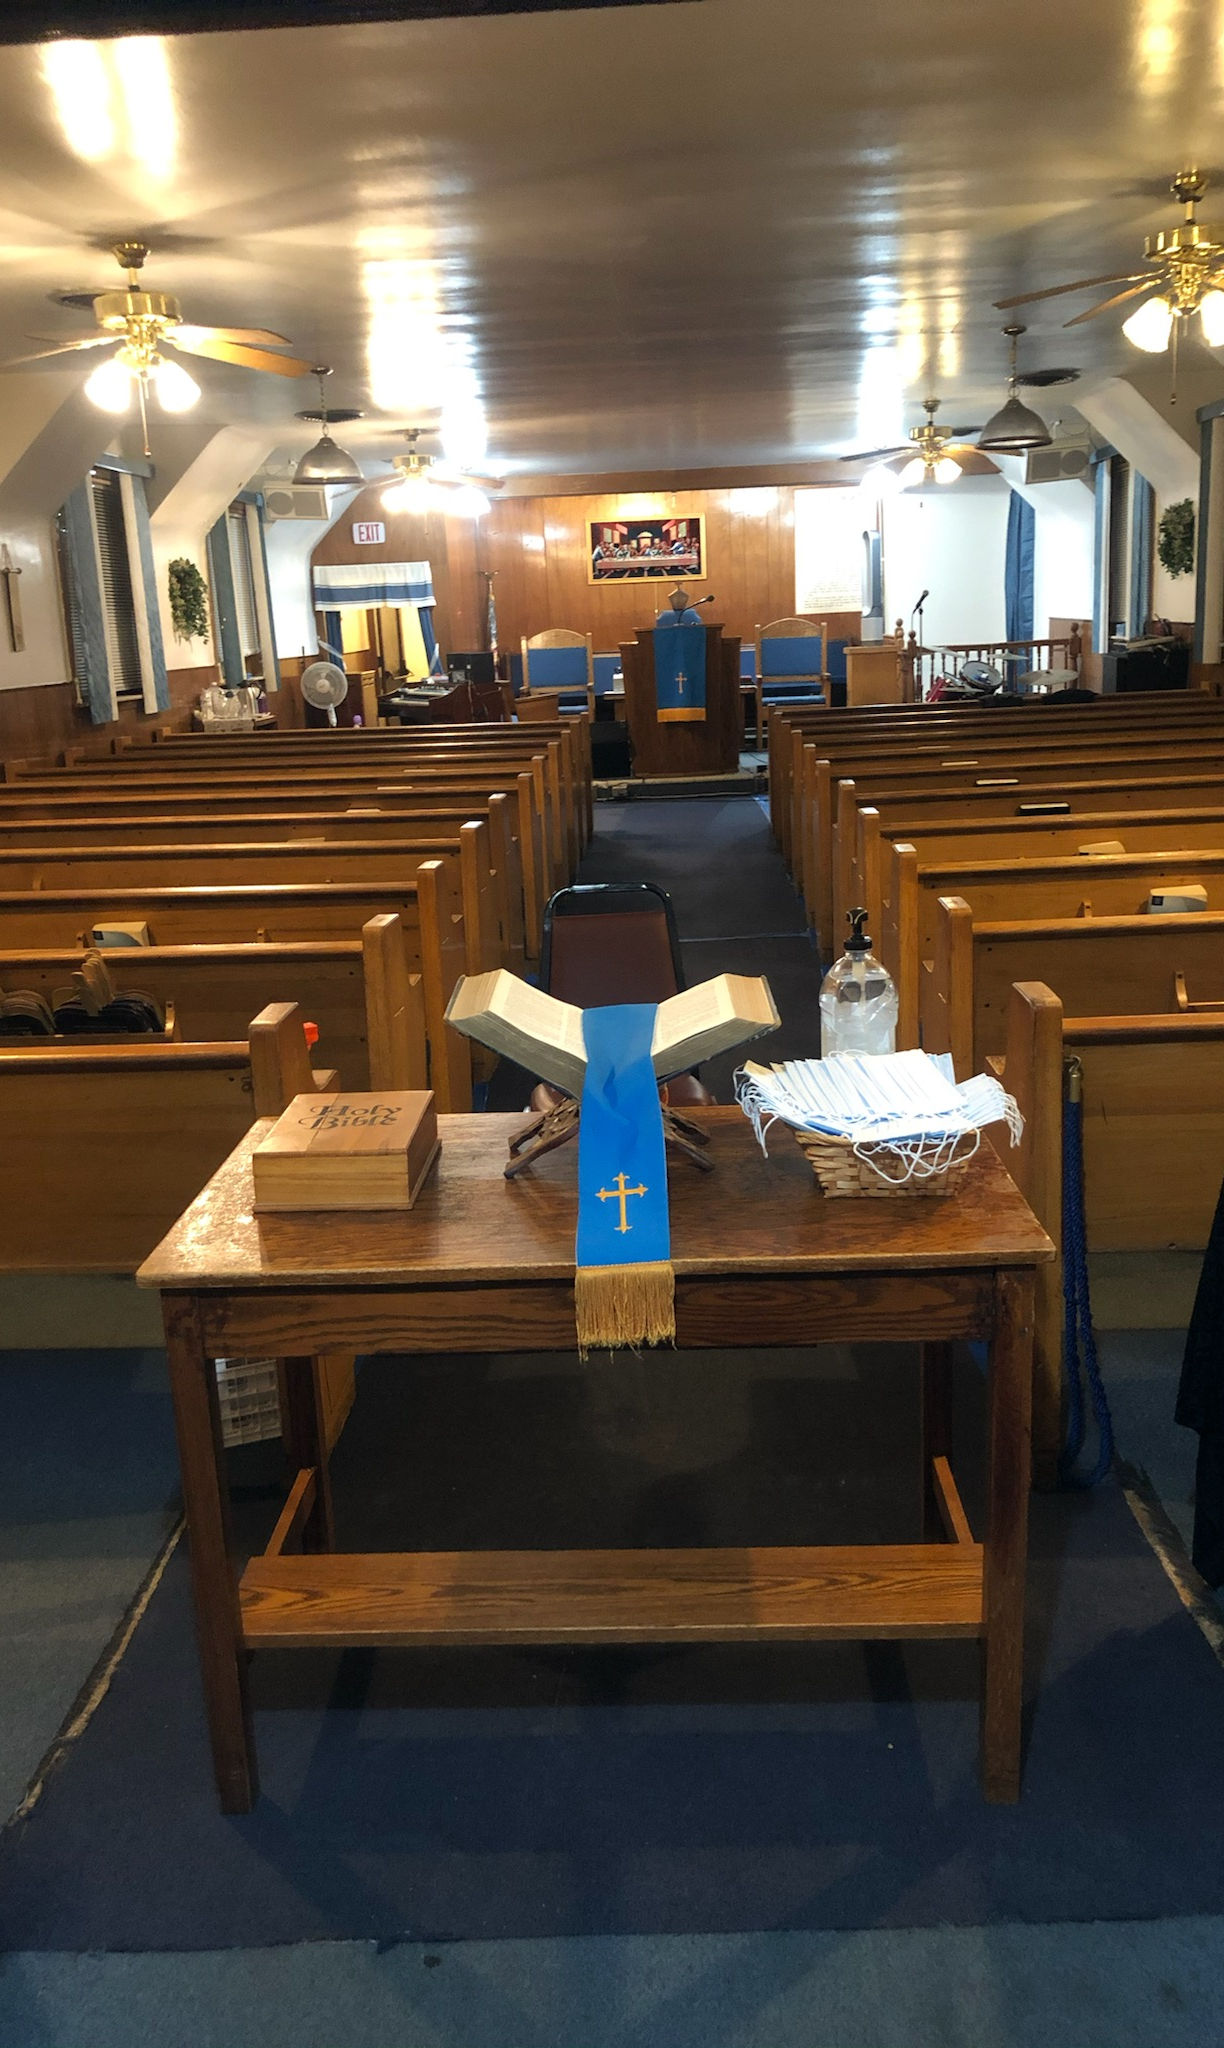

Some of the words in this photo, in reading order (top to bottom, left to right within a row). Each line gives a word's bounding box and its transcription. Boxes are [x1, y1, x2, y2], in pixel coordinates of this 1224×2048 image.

[358, 523, 380, 542] EXIT
[310, 1104, 402, 1119] Holy
[298, 1115, 398, 1130] Bible
